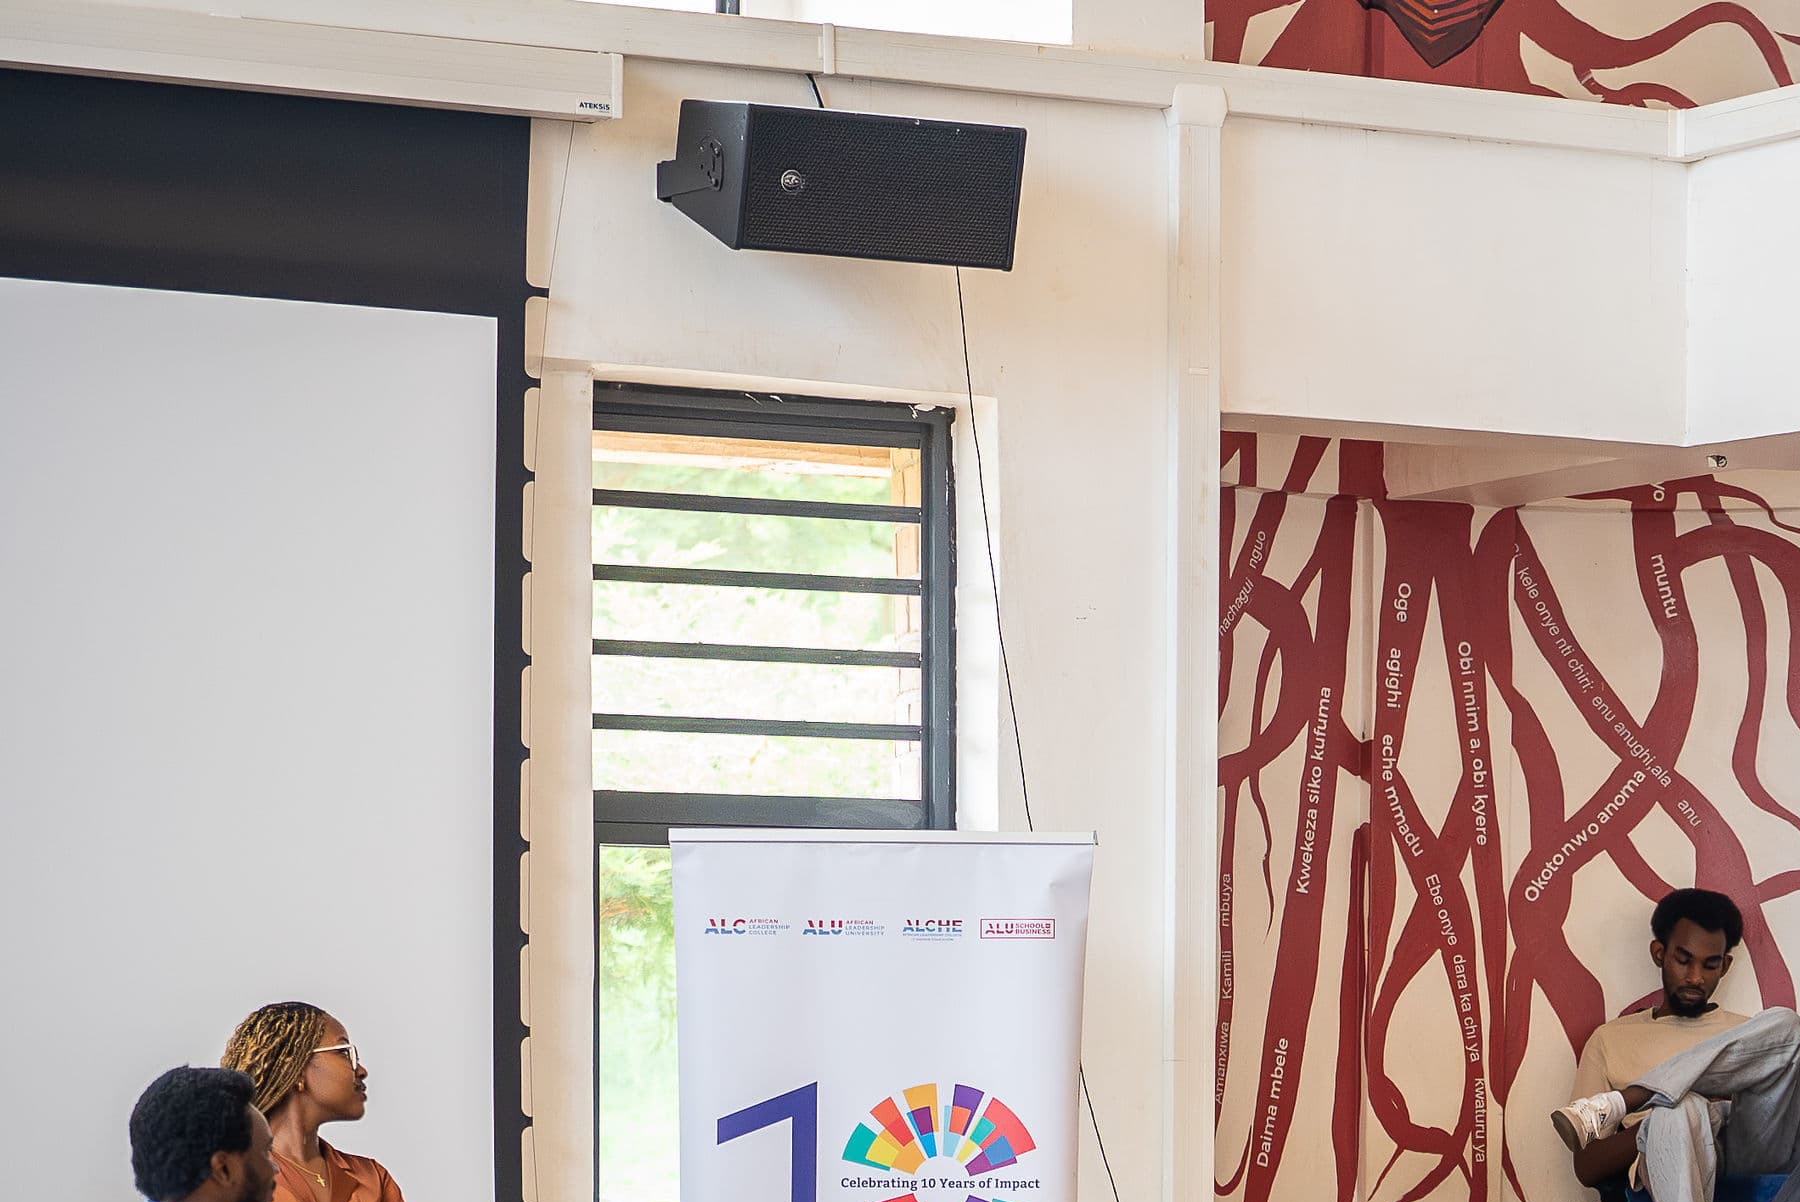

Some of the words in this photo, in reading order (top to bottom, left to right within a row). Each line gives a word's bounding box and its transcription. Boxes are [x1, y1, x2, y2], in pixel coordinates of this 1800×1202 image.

[1249, 530, 1266, 569] nguo
[1396, 582, 1412, 623] Oge
[1651, 553, 1678, 619] muntu
[1458, 641, 1473, 676] Obi
[1462, 679, 1481, 733] nnim
[1517, 566, 1539, 599] kele
[1535, 601, 1560, 637] onye
[1555, 638, 1575, 657] nti
[1592, 695, 1616, 722] enu
[1677, 799, 1701, 828] anu
[1311, 687, 1332, 761] kufuma
[1382, 734, 1397, 782] eche
[1472, 758, 1487, 790] obi
[1307, 766, 1322, 804] siko
[1384, 786, 1424, 857] mmadu
[1471, 794, 1489, 846] kyere
[1524, 852, 1564, 902] Okoto
[1597, 770, 1646, 824] anoma
[1296, 808, 1318, 894] Kwekeza
[1221, 873, 1233, 927] mbuya
[1425, 873, 1443, 906] Ebe
[704, 918, 746, 934] ALC
[802, 920, 843, 935] ALU
[902, 919, 963, 932] ALCHE
[985, 923, 1014, 934] ALU
[1438, 909, 1458, 946] onye
[1453, 954, 1468, 990] dara
[1460, 994, 1472, 1013] ka
[1465, 1045, 1480, 1062] ya
[1257, 1105, 1278, 1168] Daima
[1270, 1037, 1289, 1100] mbele
[1474, 1078, 1487, 1139] kwaturu
[1472, 1145, 1486, 1163] ya
[841, 1177, 918, 1191] Celebrating
[921, 1177, 936, 1189] 10
[939, 1177, 975, 1189] Years
[979, 1176, 992, 1189] of
[995, 1177, 1041, 1192] Impact
